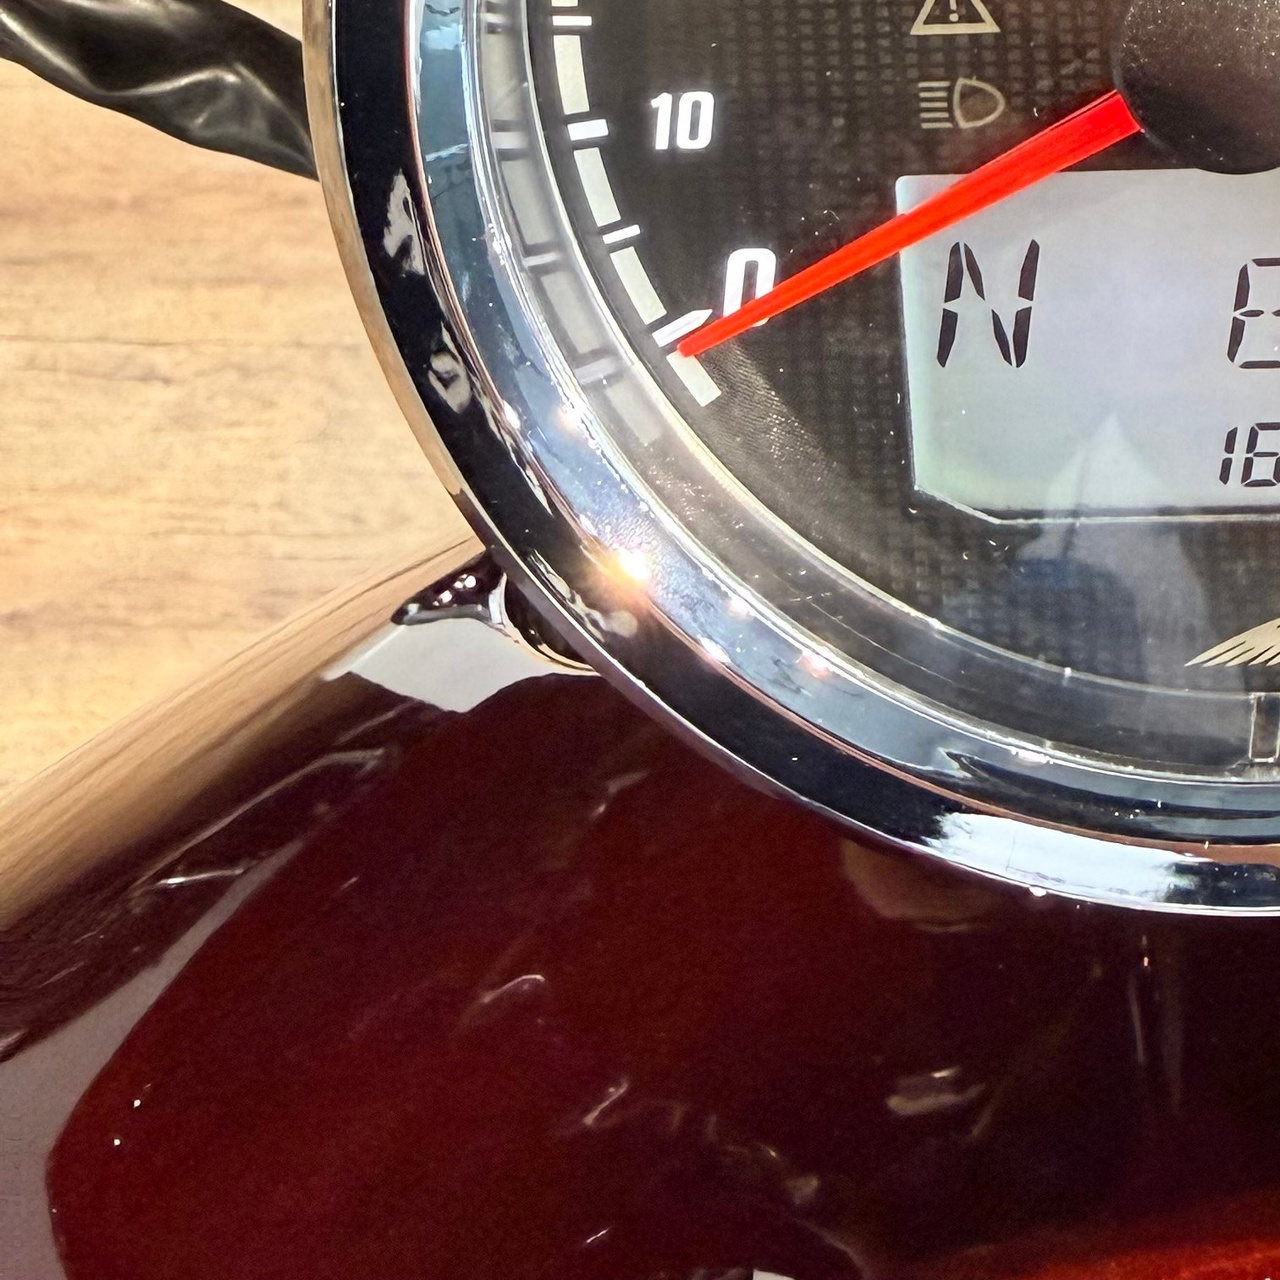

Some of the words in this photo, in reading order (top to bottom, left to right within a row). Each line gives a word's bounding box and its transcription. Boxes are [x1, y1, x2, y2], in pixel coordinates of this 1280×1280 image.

[650, 91, 715, 150] 10
[723, 247, 777, 327] 0
[937, 239, 1040, 368] N
